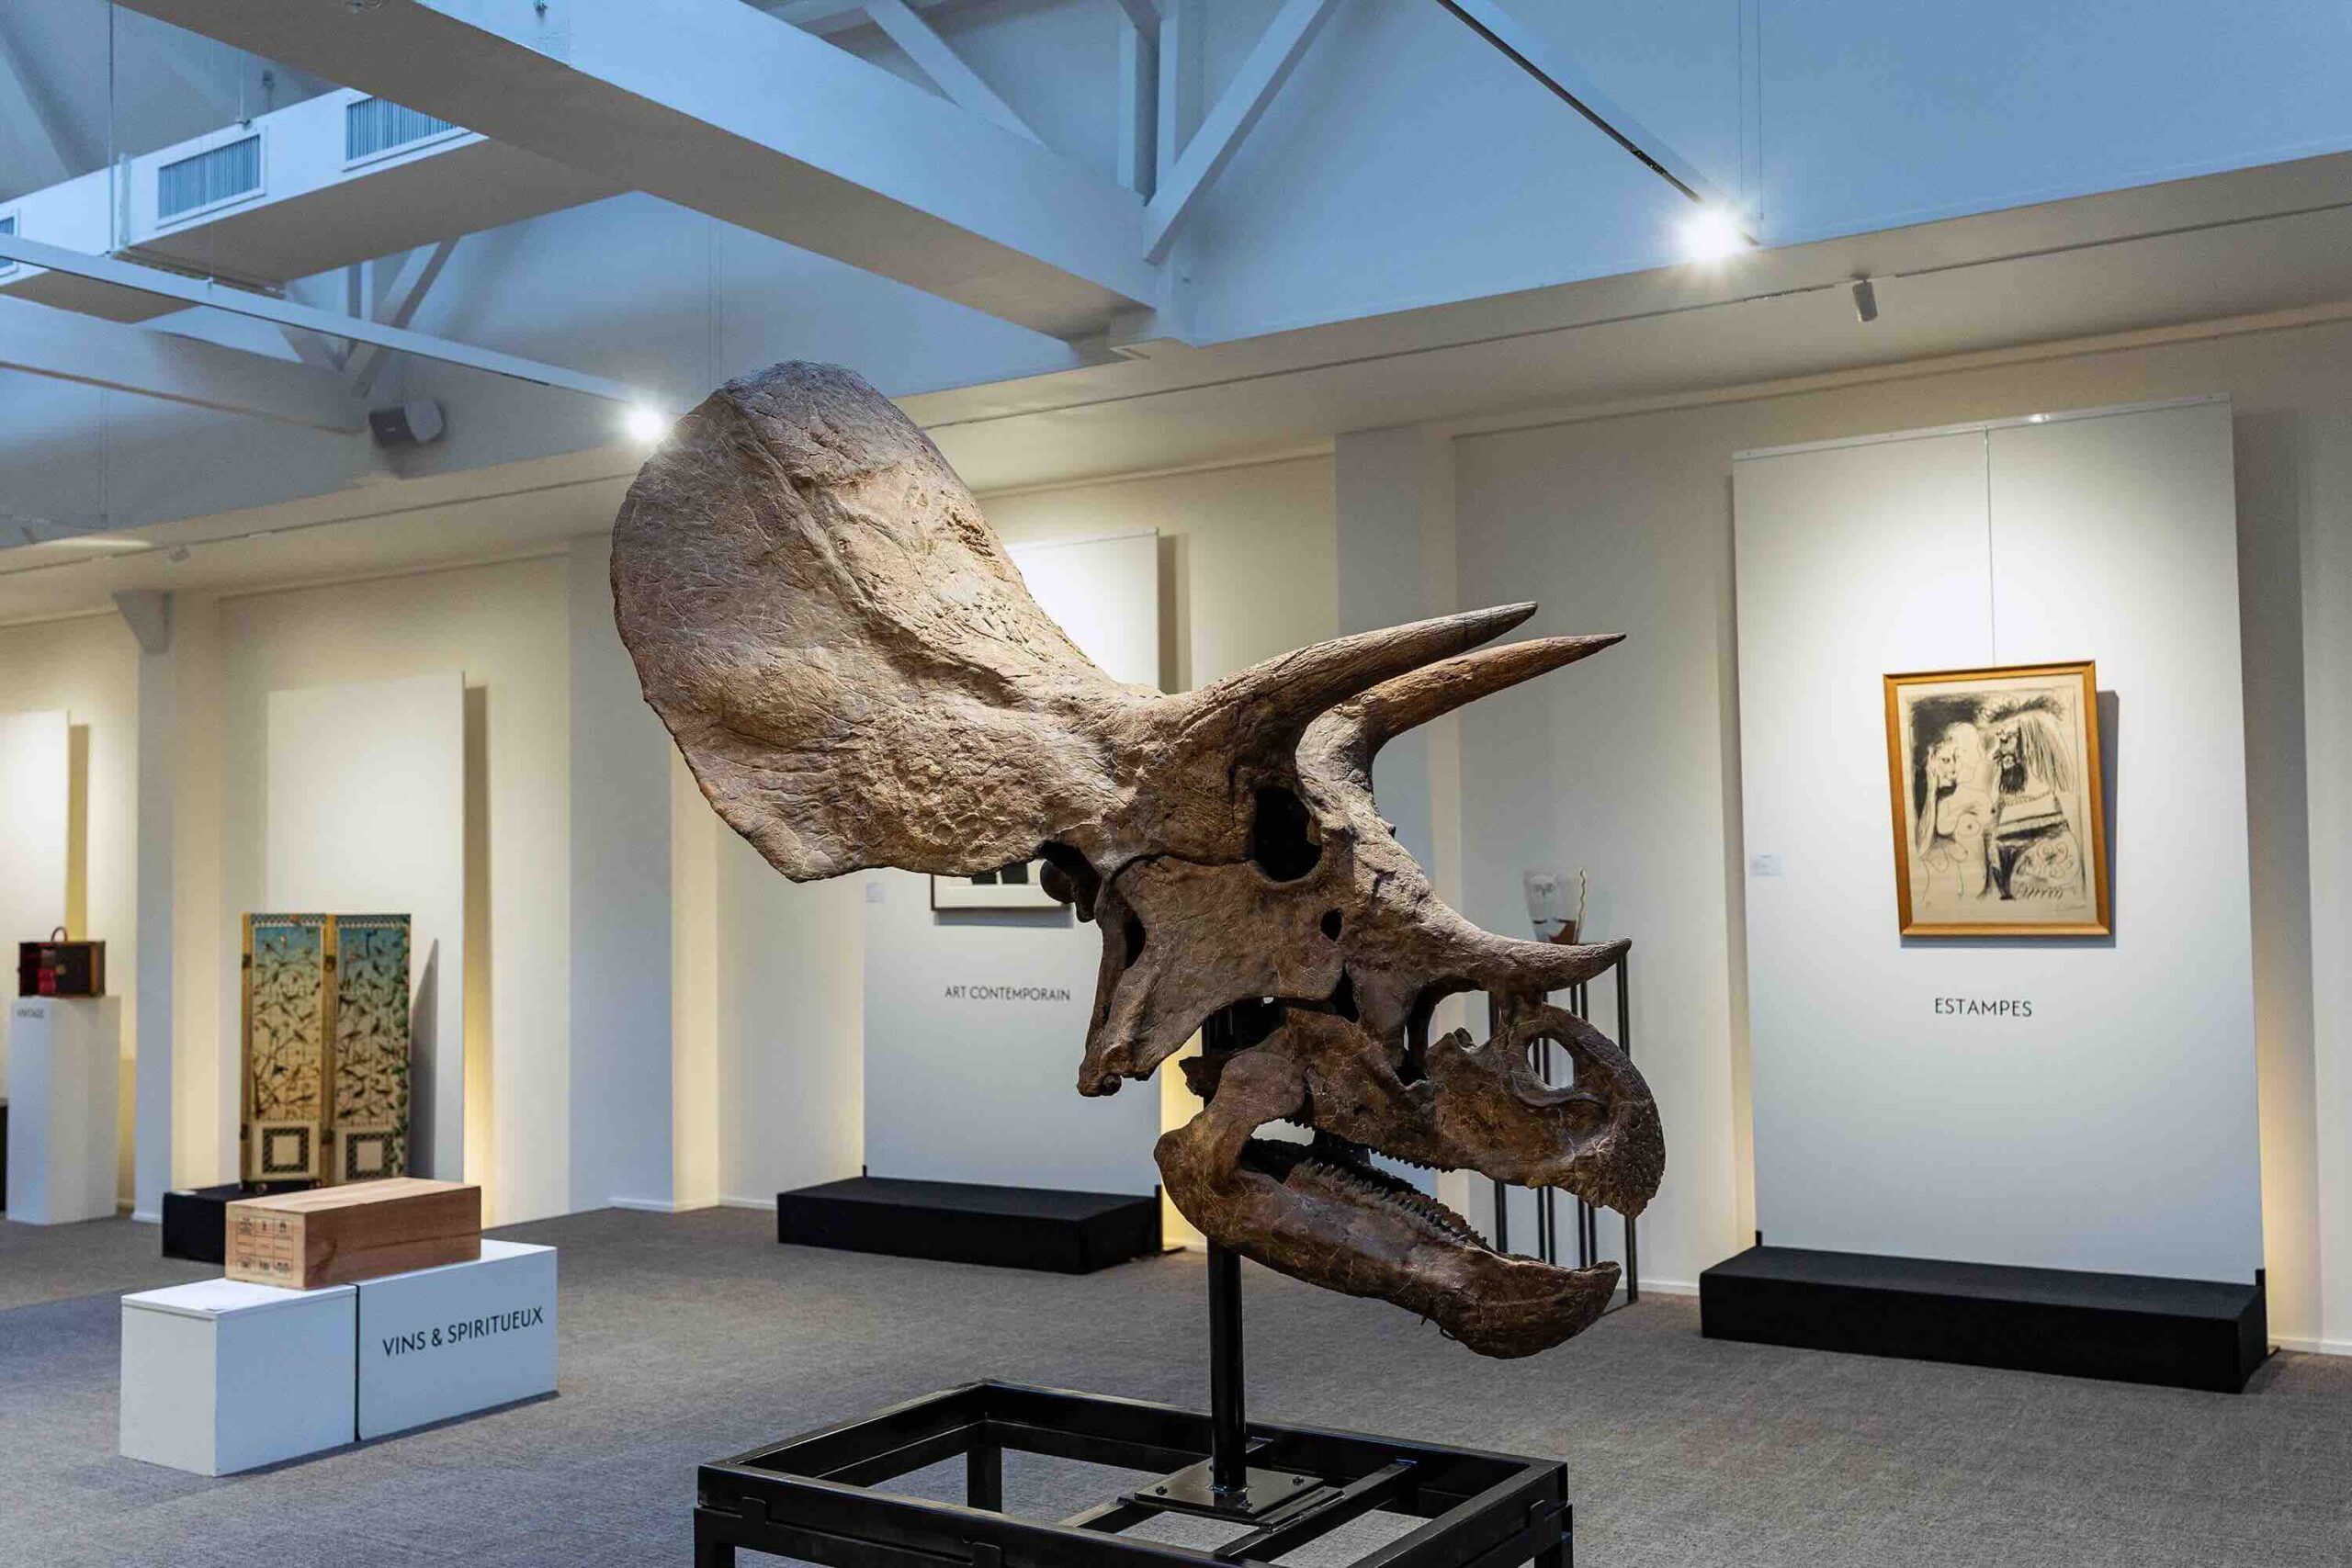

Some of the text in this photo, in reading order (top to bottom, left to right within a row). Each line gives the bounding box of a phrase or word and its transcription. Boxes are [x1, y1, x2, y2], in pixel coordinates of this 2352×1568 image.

[945, 986, 1070, 1001] ART CONTEMPORAIN
[1935, 998, 2032, 1017] ESTAMPES
[382, 1306, 544, 1357] VINS & SPIRITUEUX
